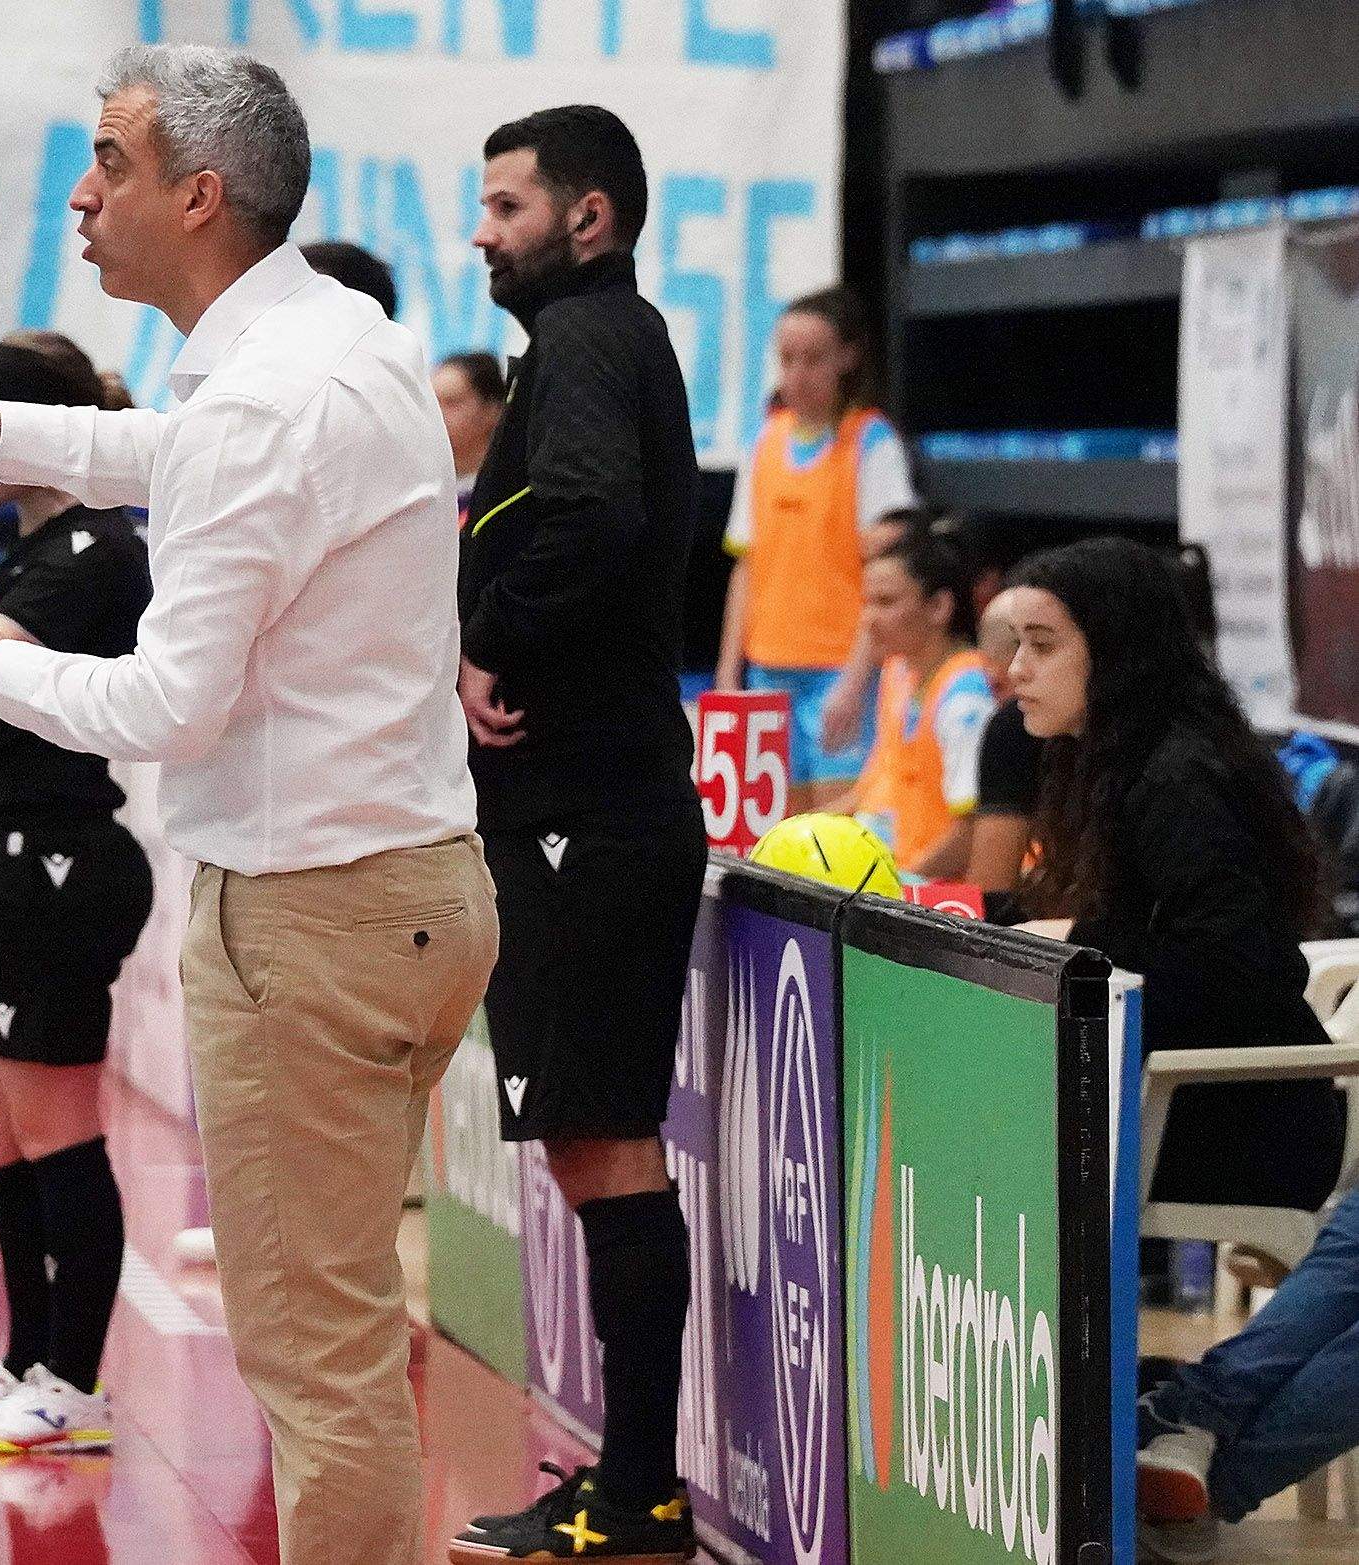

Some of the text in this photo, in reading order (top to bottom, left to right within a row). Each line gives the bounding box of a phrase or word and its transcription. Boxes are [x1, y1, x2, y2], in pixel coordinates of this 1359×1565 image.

[700, 710, 787, 840] 55
[785, 1157, 807, 1245] RF
[787, 1280, 810, 1369] EF
[901, 1164, 1056, 1565] Iberdrola
